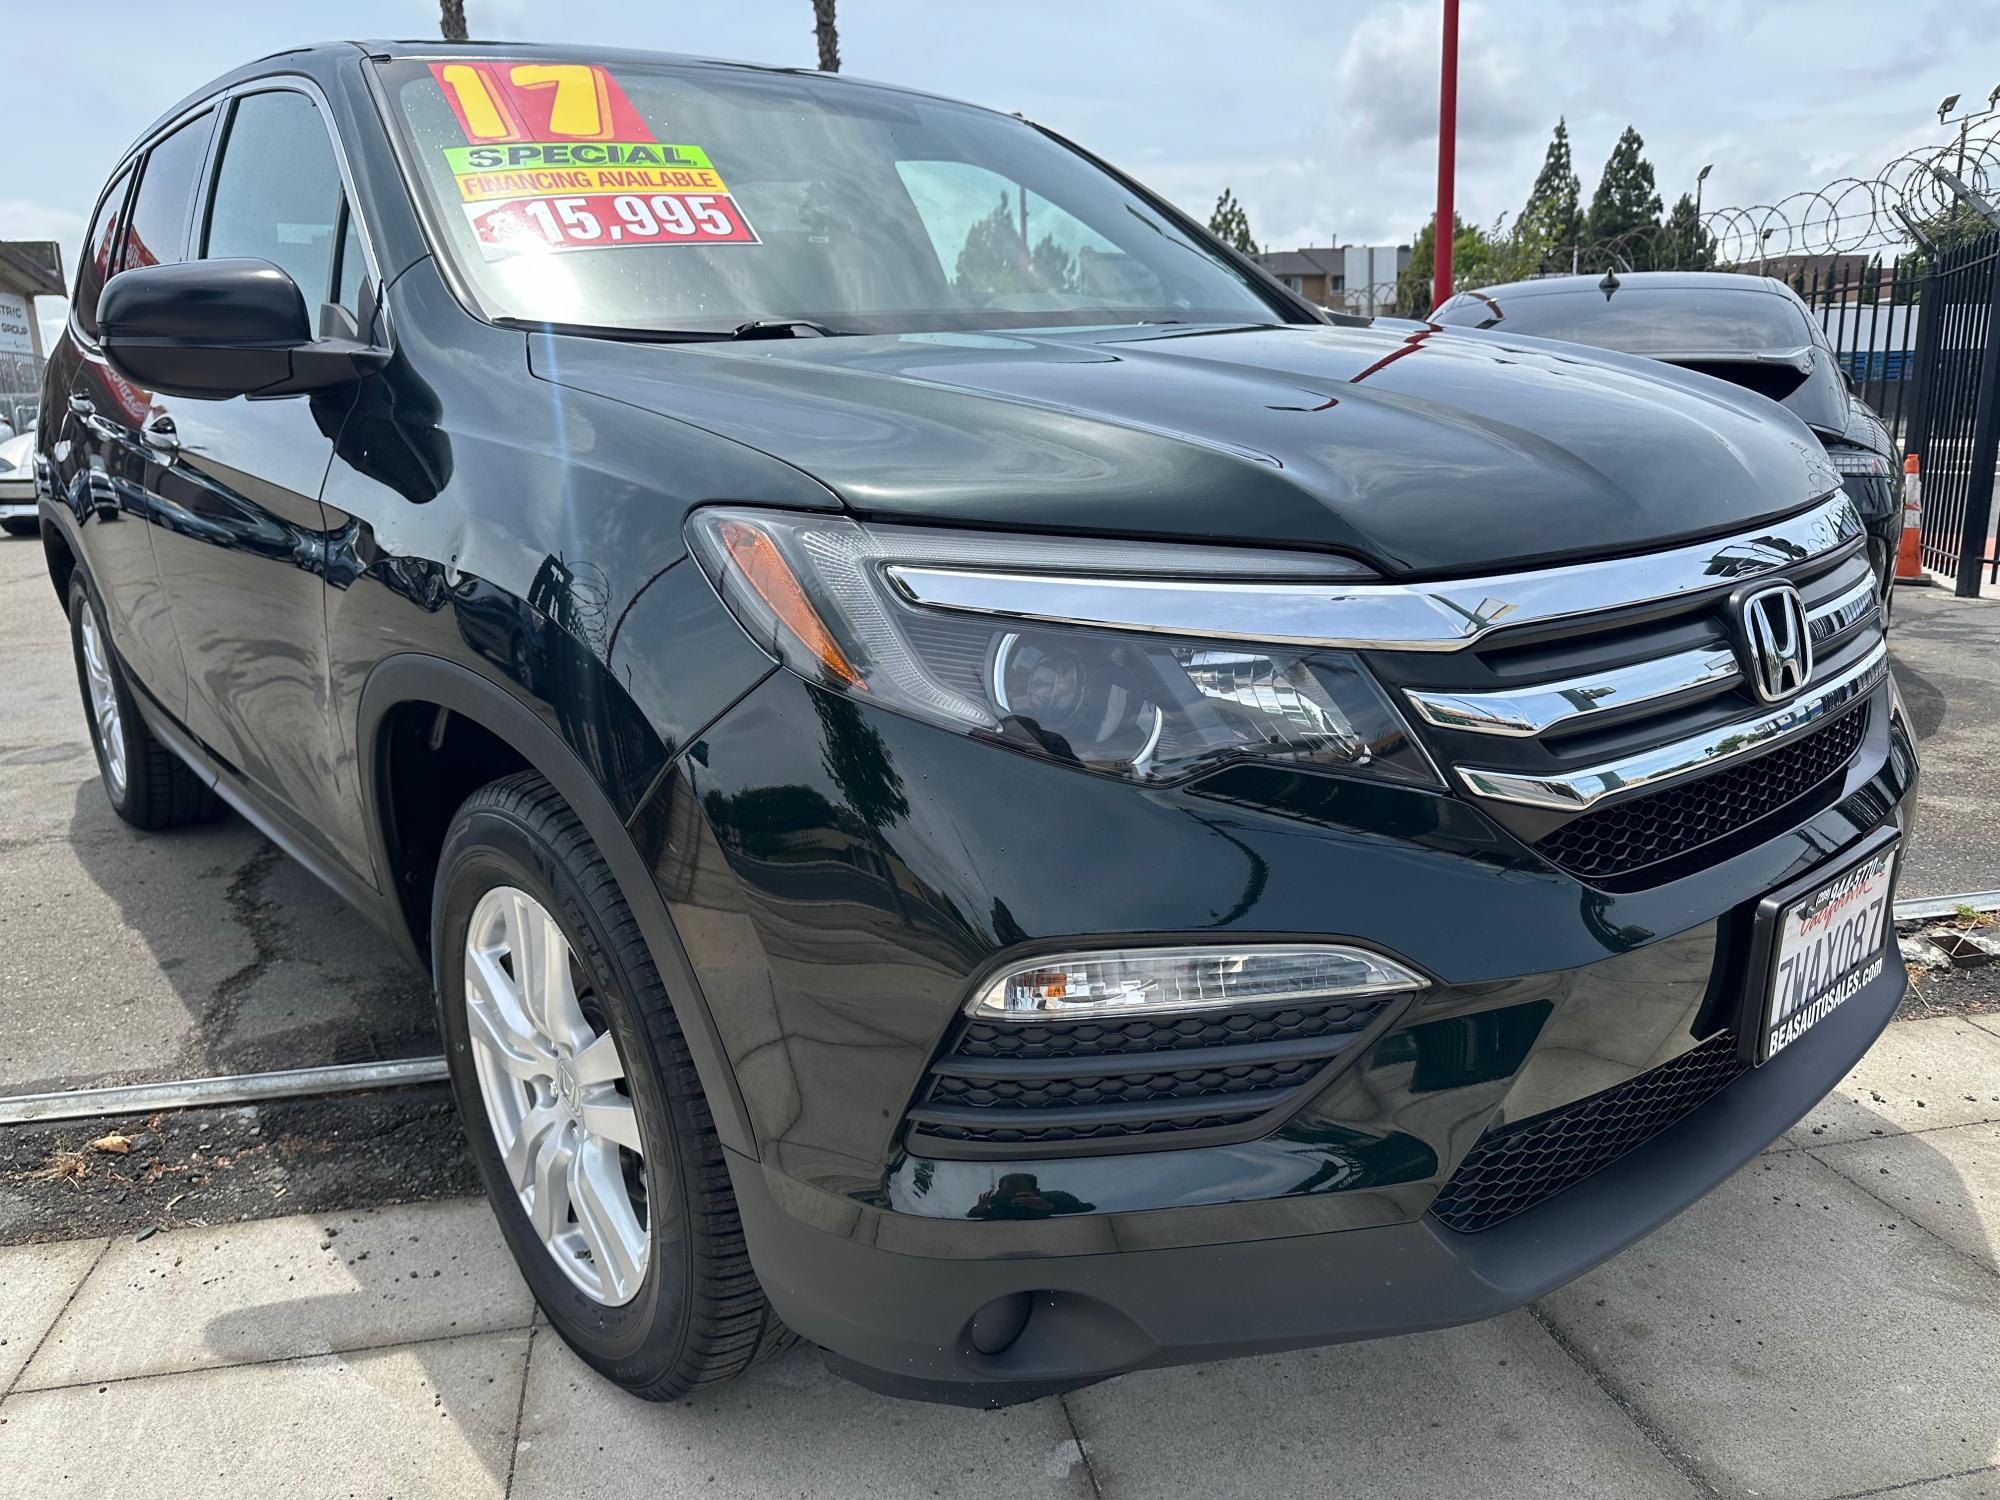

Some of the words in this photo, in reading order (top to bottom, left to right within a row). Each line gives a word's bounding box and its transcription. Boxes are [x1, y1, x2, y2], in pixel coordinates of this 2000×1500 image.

[442, 64, 613, 140] 17
[468, 144, 697, 170] SPECIAL
[463, 170, 592, 196] FINANCING
[600, 171, 718, 188] AVAILABLE
[0, 304, 22, 319] TRIC
[1, 322, 28, 335] GROUP
[1800, 877, 1873, 937] California
[1780, 896, 1884, 1022] 7WAX087
[1768, 956, 1884, 1058] BEASAUTOSALES.com
